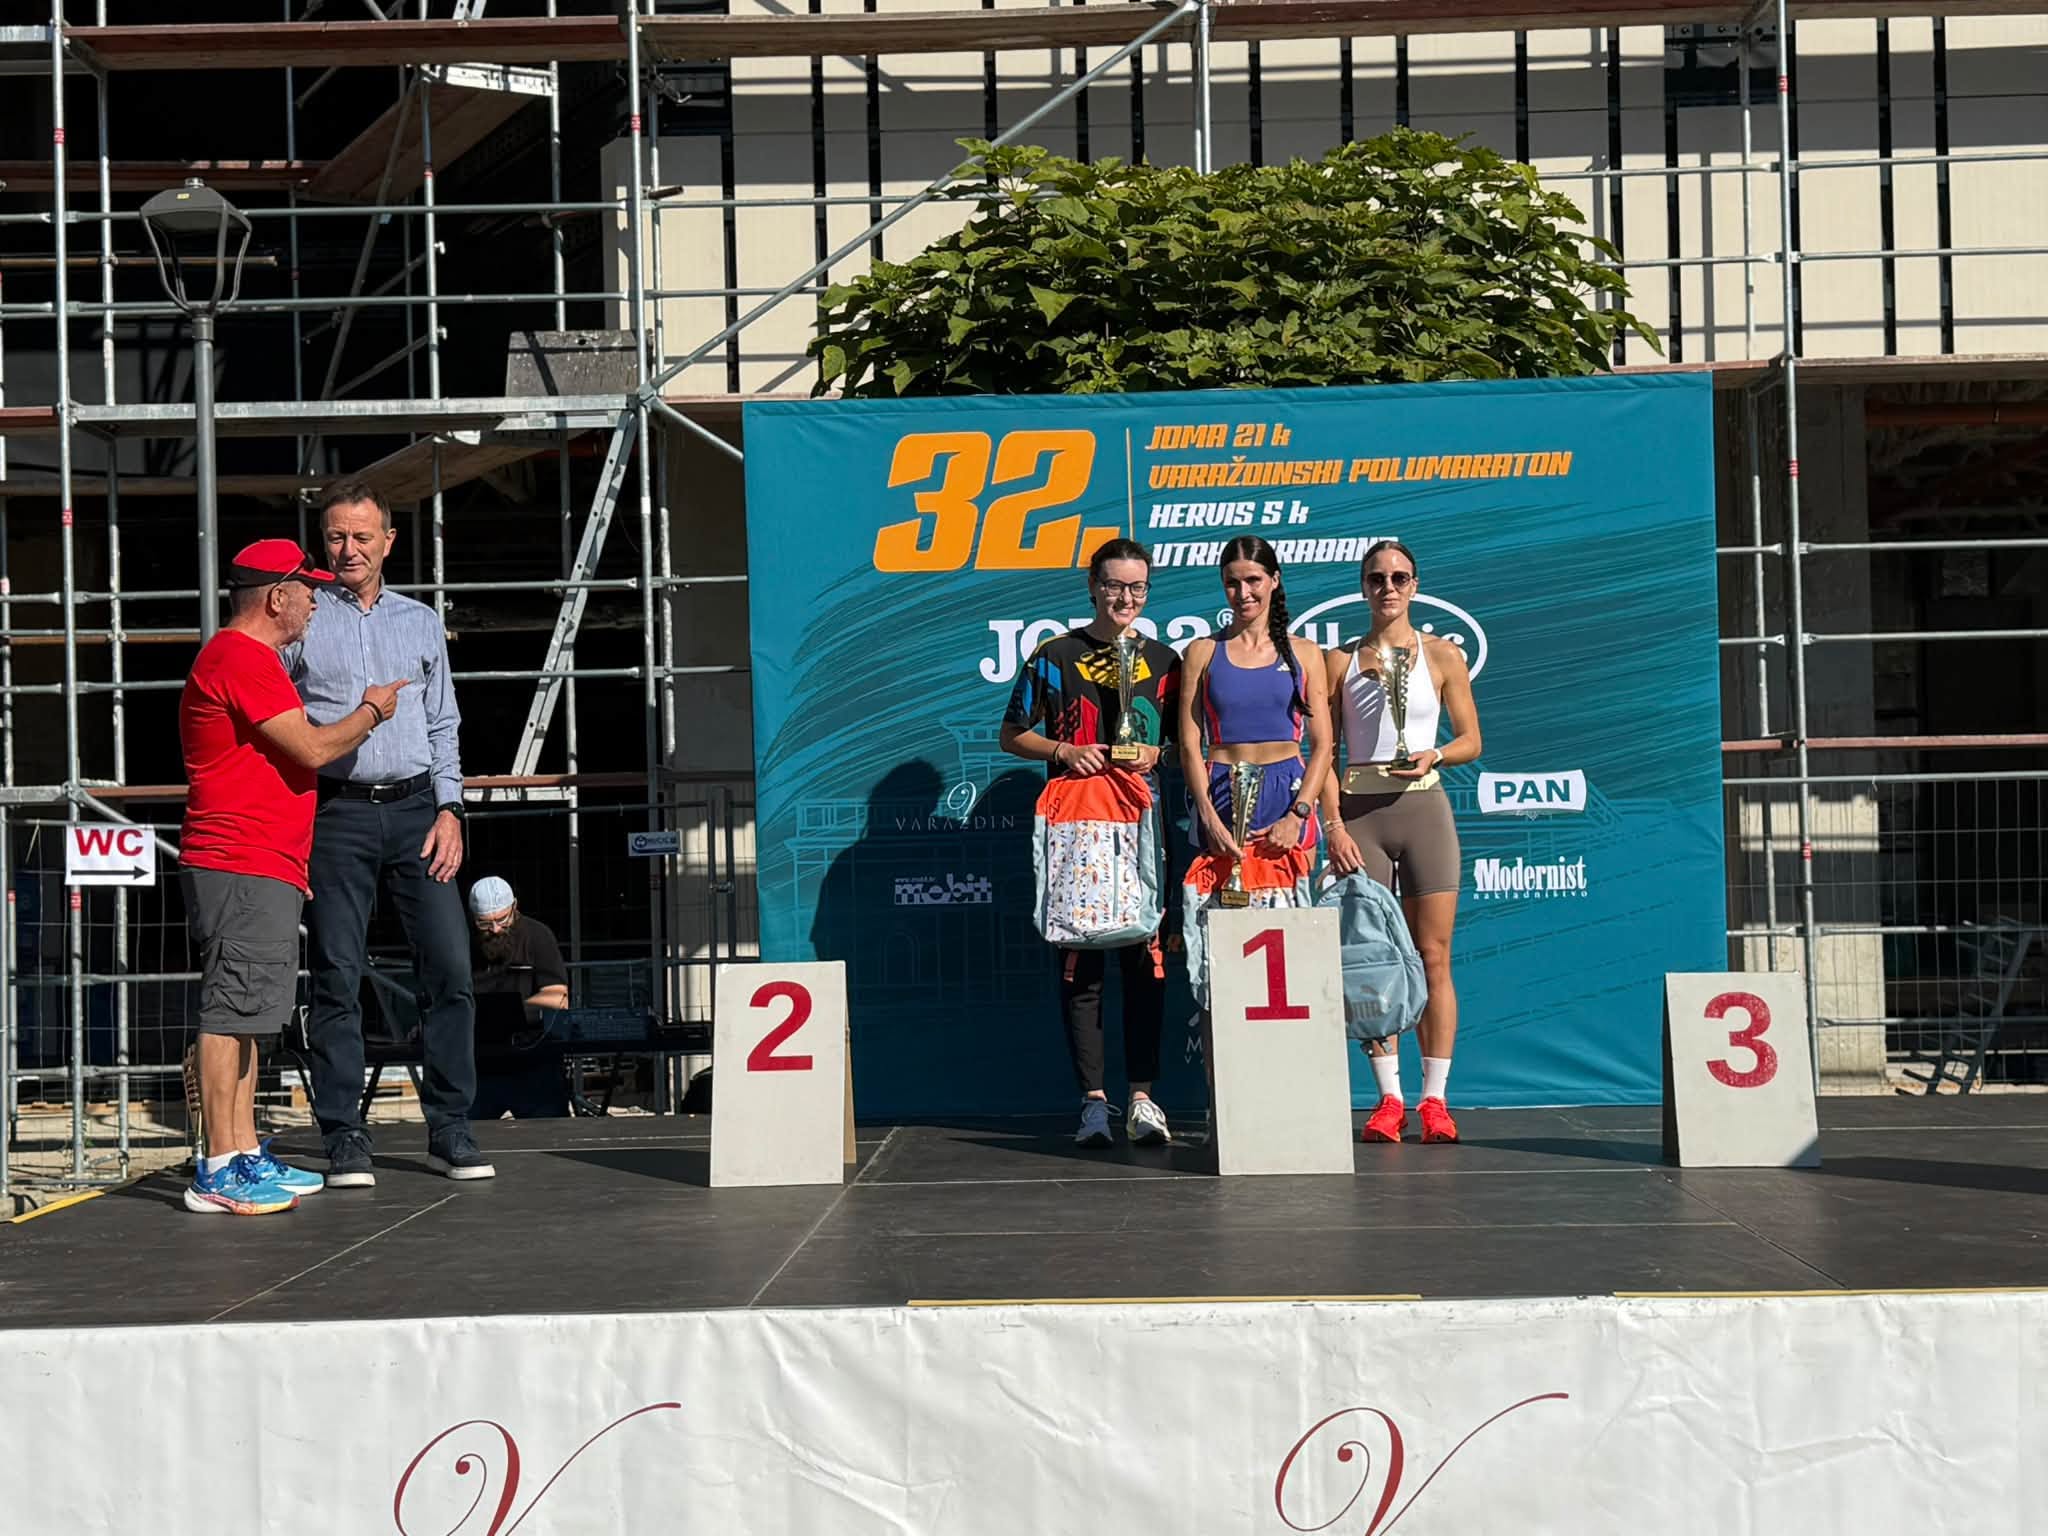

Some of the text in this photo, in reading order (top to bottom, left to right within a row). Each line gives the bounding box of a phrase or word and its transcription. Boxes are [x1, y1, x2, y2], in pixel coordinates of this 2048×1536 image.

[1145, 423, 1292, 450] JOMA 21 k
[1148, 451, 1572, 489] VARAŽDINSKI POLUMARATON
[873, 429, 1120, 572] 32.
[1149, 500, 1310, 528] HERVIS 5 k
[1151, 541, 1228, 567] UTRK
[1494, 779, 1570, 804] PAN
[75, 828, 144, 856] WC
[1474, 856, 1587, 891] Modernist
[1243, 929, 1310, 1021] 1
[747, 981, 813, 1072] 2
[1704, 991, 1778, 1089] 3
